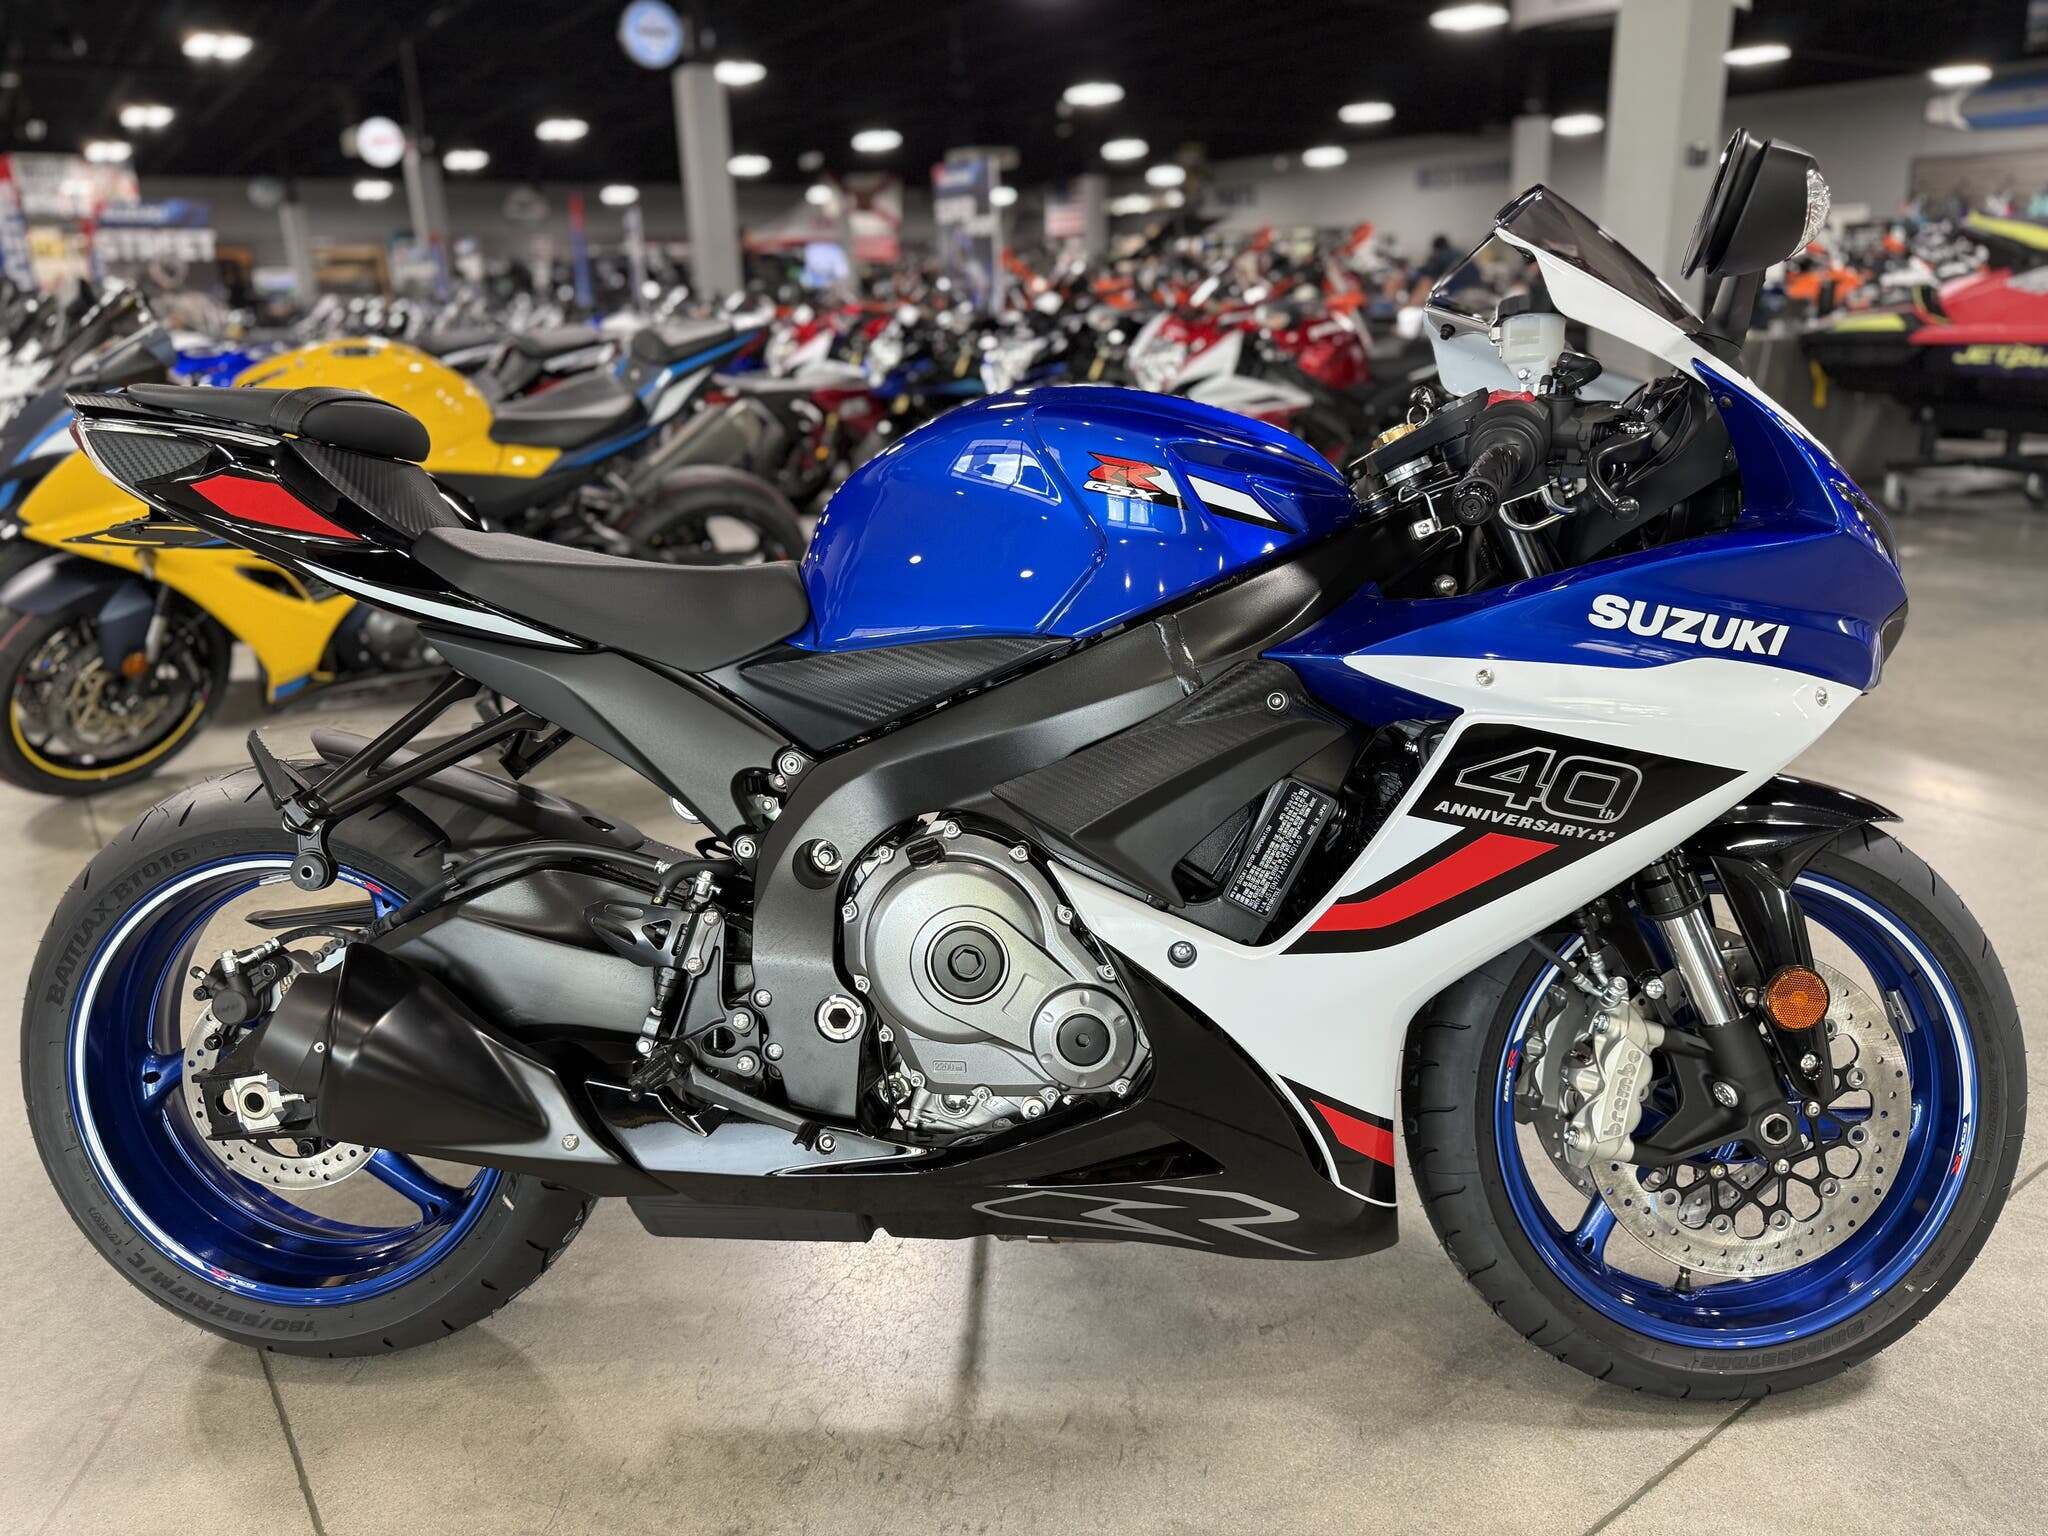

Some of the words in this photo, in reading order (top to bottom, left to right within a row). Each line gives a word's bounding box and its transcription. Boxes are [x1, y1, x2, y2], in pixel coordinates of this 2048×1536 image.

[1588, 594, 1790, 656] SUZUKI
[1434, 800, 1591, 840] ANNIVERSARY
[1455, 746, 1643, 823] 40
[46, 899, 114, 1006] BATTLAX
[111, 848, 192, 899] BT016
[1603, 1050, 1640, 1135] brembo
